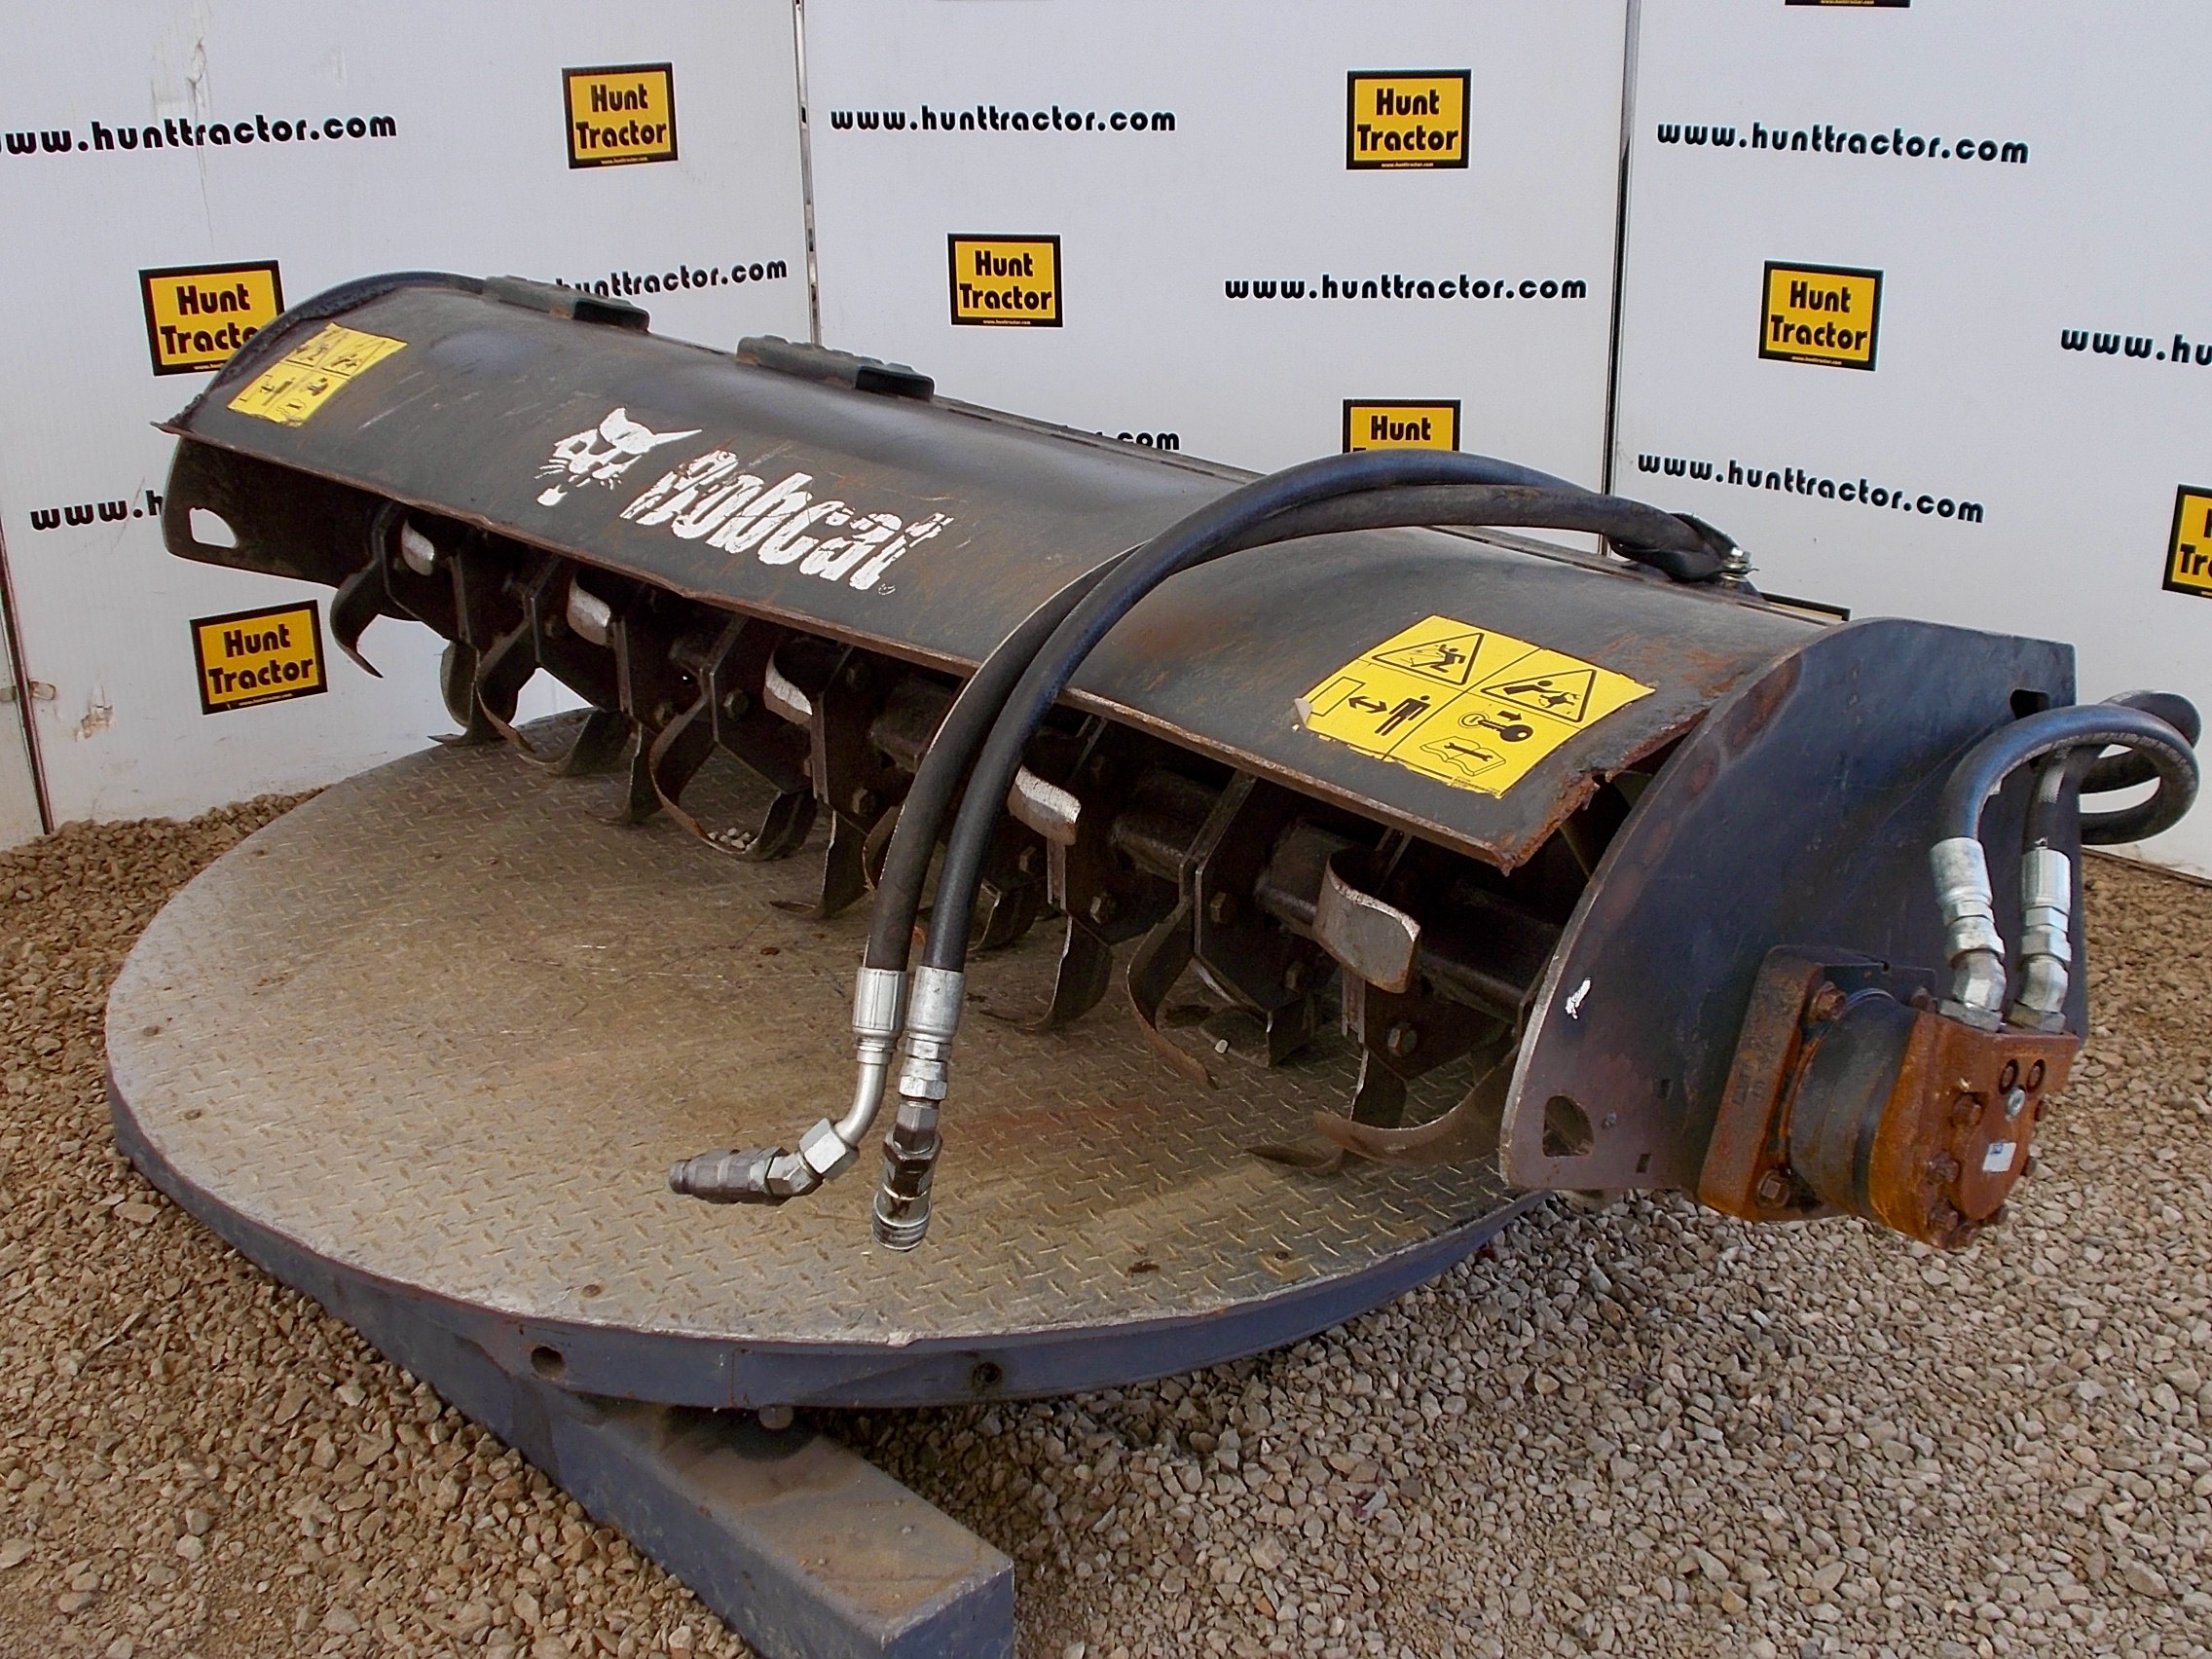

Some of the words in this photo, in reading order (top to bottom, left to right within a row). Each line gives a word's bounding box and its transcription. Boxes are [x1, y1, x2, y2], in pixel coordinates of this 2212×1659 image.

[591, 84, 647, 112] Hunt
[1377, 89, 1439, 115] Hunt
[831, 106, 1175, 130] www.hunttractor.com
[0, 115, 396, 155] ww.hunttractor.com
[576, 121, 666, 149] Tractor
[1357, 125, 1458, 151] Tractor
[1658, 123, 2027, 163] www.hunttractor.com
[976, 251, 1033, 276] Hunt
[176, 284, 250, 314] Hunt
[960, 283, 1051, 310] Tractor
[1226, 275, 1586, 299] www.hunttractor.com
[1790, 280, 1850, 313] Hunt
[1771, 314, 1867, 350] Tractor
[1371, 416, 1430, 440] Hunt
[1638, 454, 1984, 523] www.hunttractor.com
[224, 624, 290, 657] Hunt
[207, 658, 313, 695] Tractor
